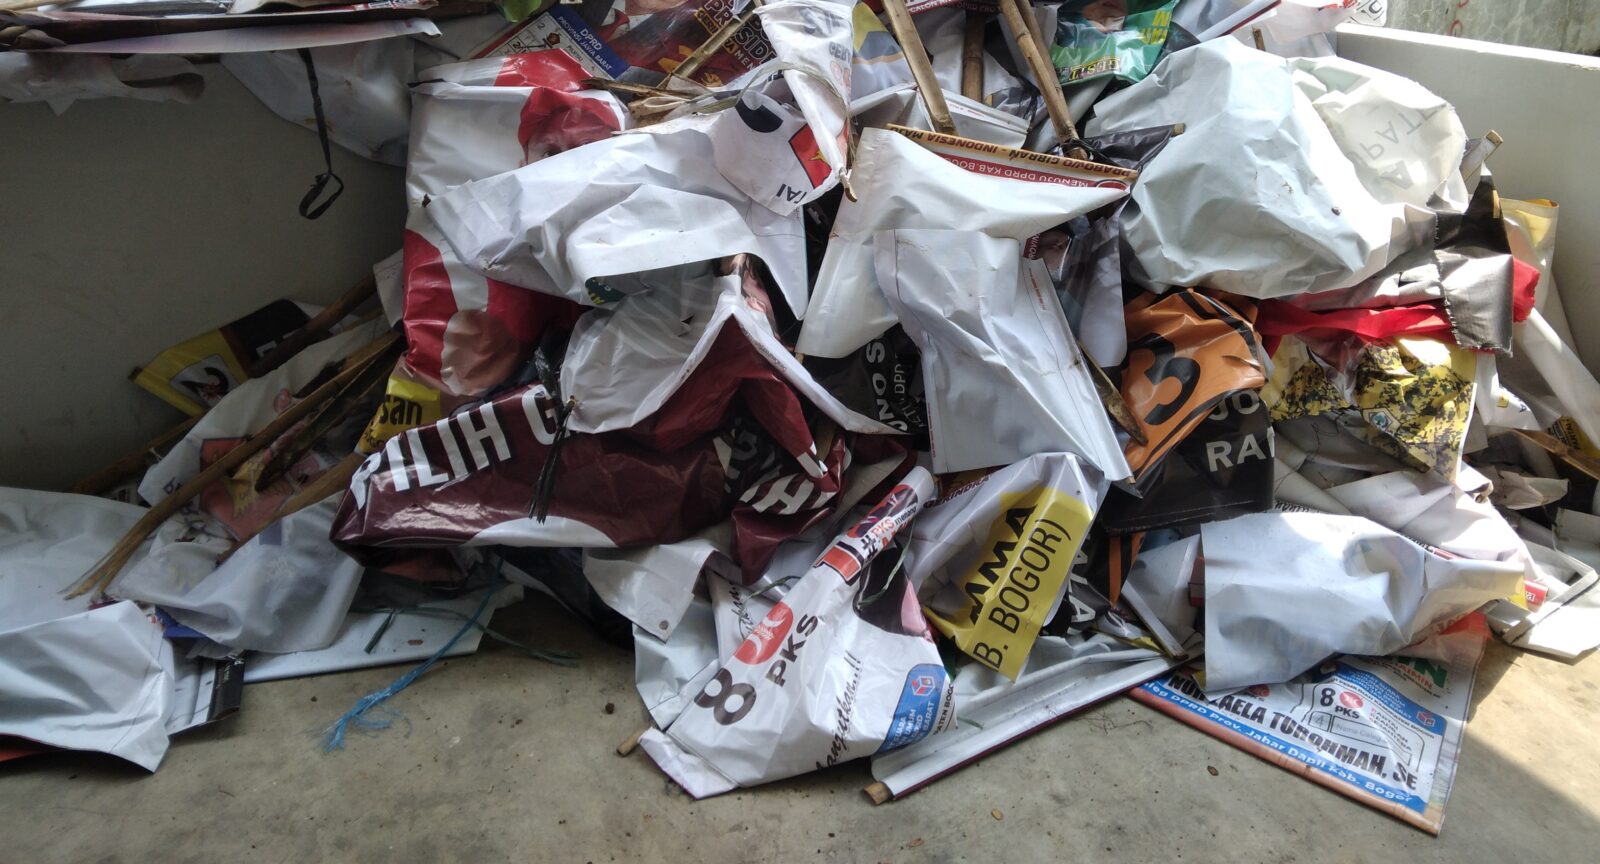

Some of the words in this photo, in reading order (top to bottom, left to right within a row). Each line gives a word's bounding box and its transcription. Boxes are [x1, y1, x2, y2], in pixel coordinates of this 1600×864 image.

[558, 16, 582, 42] PROVINSI
[579, 39, 596, 56] JAWA
[594, 54, 612, 71] BARAT
[579, 27, 603, 51] DPRD
[927, 133, 998, 154] INDONESIA
[1008, 149, 1060, 166] GIBRAN
[1063, 160, 1130, 179] PRABOWO
[1004, 169, 1036, 181] DPRD
[350, 401, 512, 511] PILIH
[988, 518, 1071, 634] BOGOR)
[765, 613, 820, 688] PKS
[694, 667, 757, 727] 8
[1319, 686, 1336, 708] 8
[903, 708, 916, 735] UMUM
[1335, 705, 1361, 720] PKS
[1388, 702, 1412, 720] BARAT
[1170, 694, 1208, 715] DPRD
[1209, 711, 1242, 733] Prov.
[1247, 730, 1286, 753] Jabar
[1287, 746, 1327, 769] Dapil
[1328, 764, 1360, 785] Kab.
[1363, 781, 1413, 803] Bogor
[1392, 762, 1418, 791] SE
